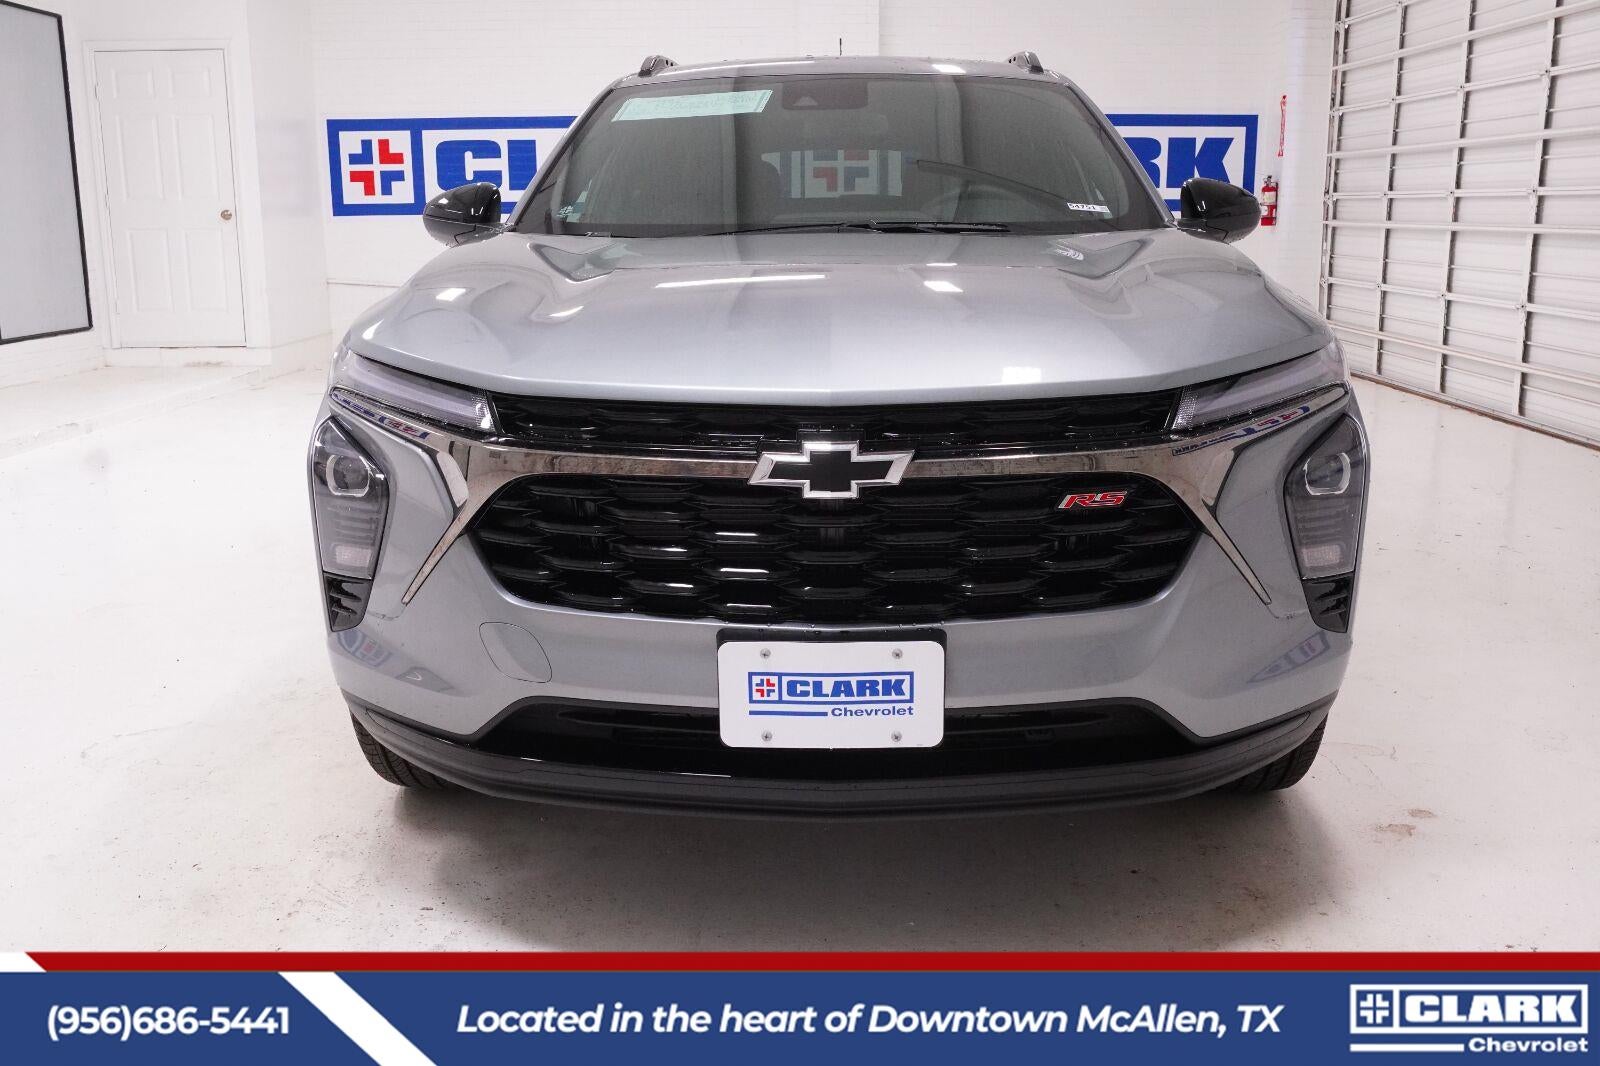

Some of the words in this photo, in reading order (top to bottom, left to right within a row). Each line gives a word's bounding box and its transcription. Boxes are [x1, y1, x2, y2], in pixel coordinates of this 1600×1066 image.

[1058, 491, 1127, 509] RS
[786, 678, 906, 698] CLARK
[831, 705, 914, 717] Chevrolet
